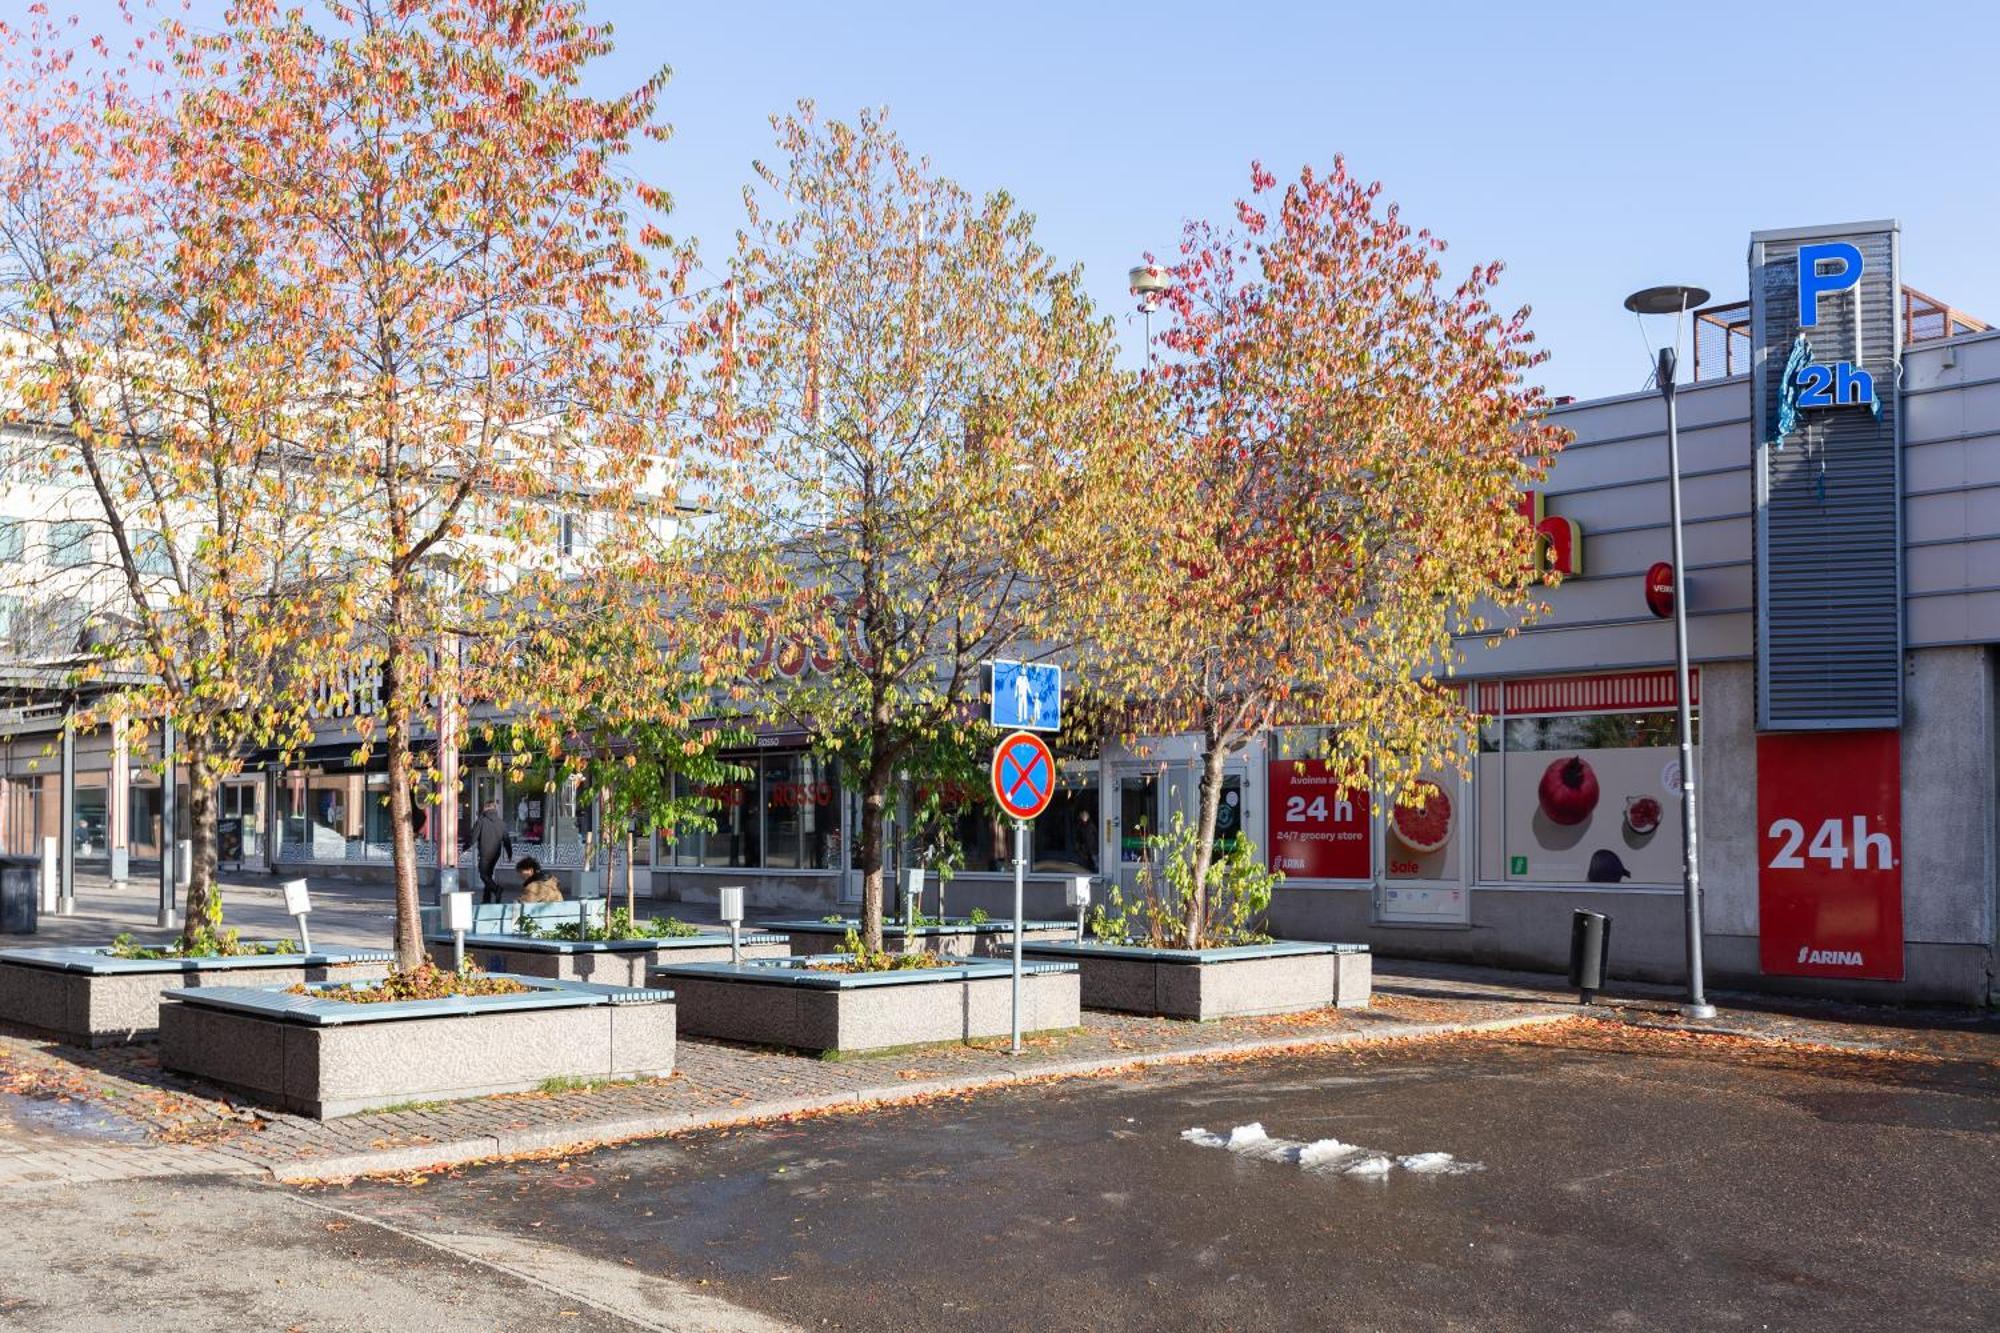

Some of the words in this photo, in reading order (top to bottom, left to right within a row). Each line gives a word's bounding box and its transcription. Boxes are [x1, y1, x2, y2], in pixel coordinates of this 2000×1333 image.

[1797, 241, 1864, 329] P
[1796, 360, 1874, 407] 2h
[757, 736, 780, 748] ROSSO
[1290, 775, 1327, 785] Avoinna
[772, 780, 833, 807] ROSSO
[1276, 831, 1298, 841] 24/7
[1299, 832, 1335, 842] grocery
[1337, 831, 1363, 841] store
[1768, 815, 1893, 870] 24h
[1809, 951, 1863, 965] ARINA
